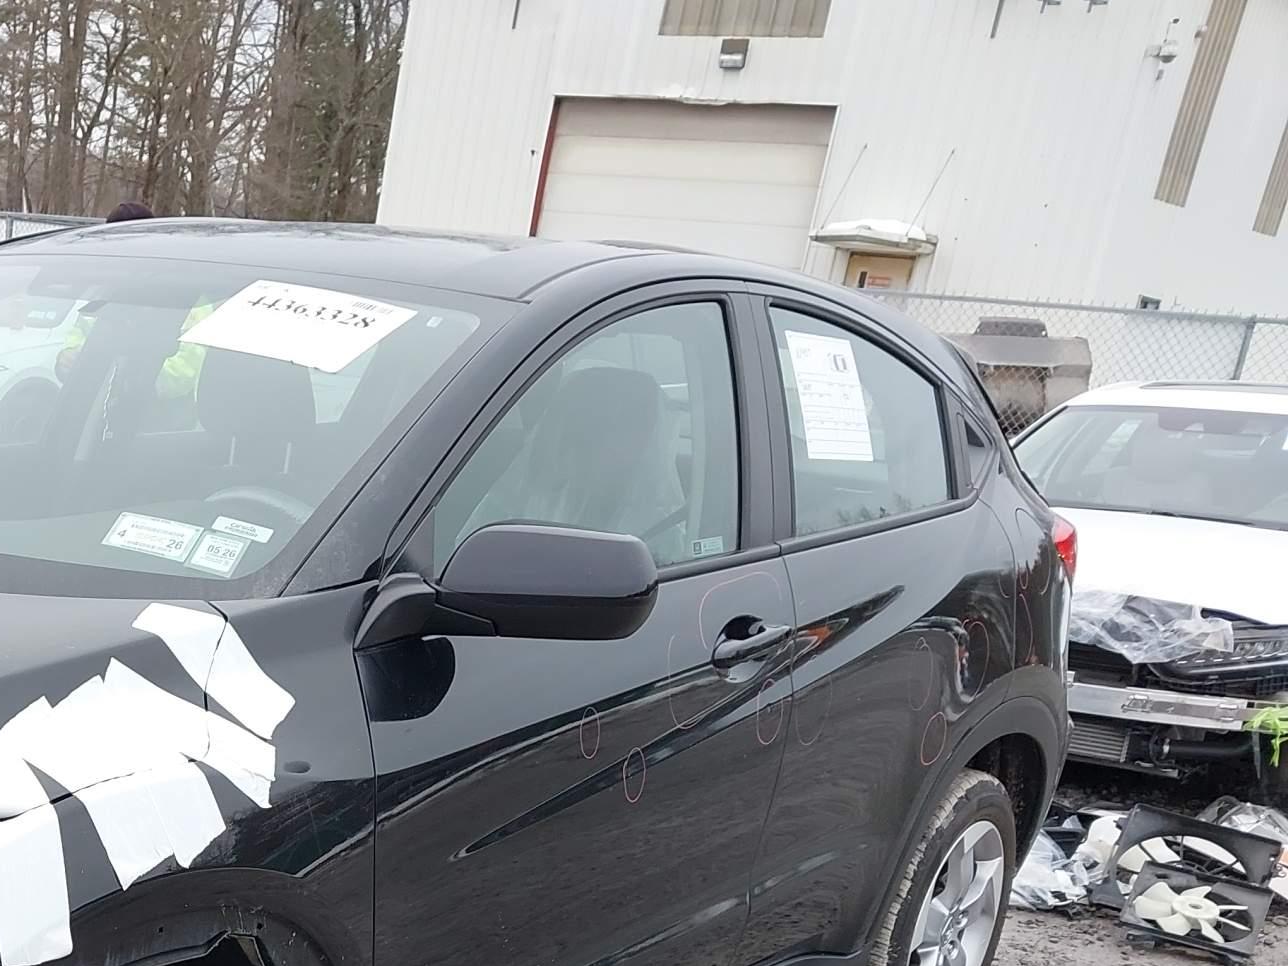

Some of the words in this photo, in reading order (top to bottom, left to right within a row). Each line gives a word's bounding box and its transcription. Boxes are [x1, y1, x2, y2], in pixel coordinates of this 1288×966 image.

[247, 295, 376, 329] 44363328
[117, 529, 128, 539] 4
[166, 538, 184, 551] 26
[207, 543, 222, 555] 05
